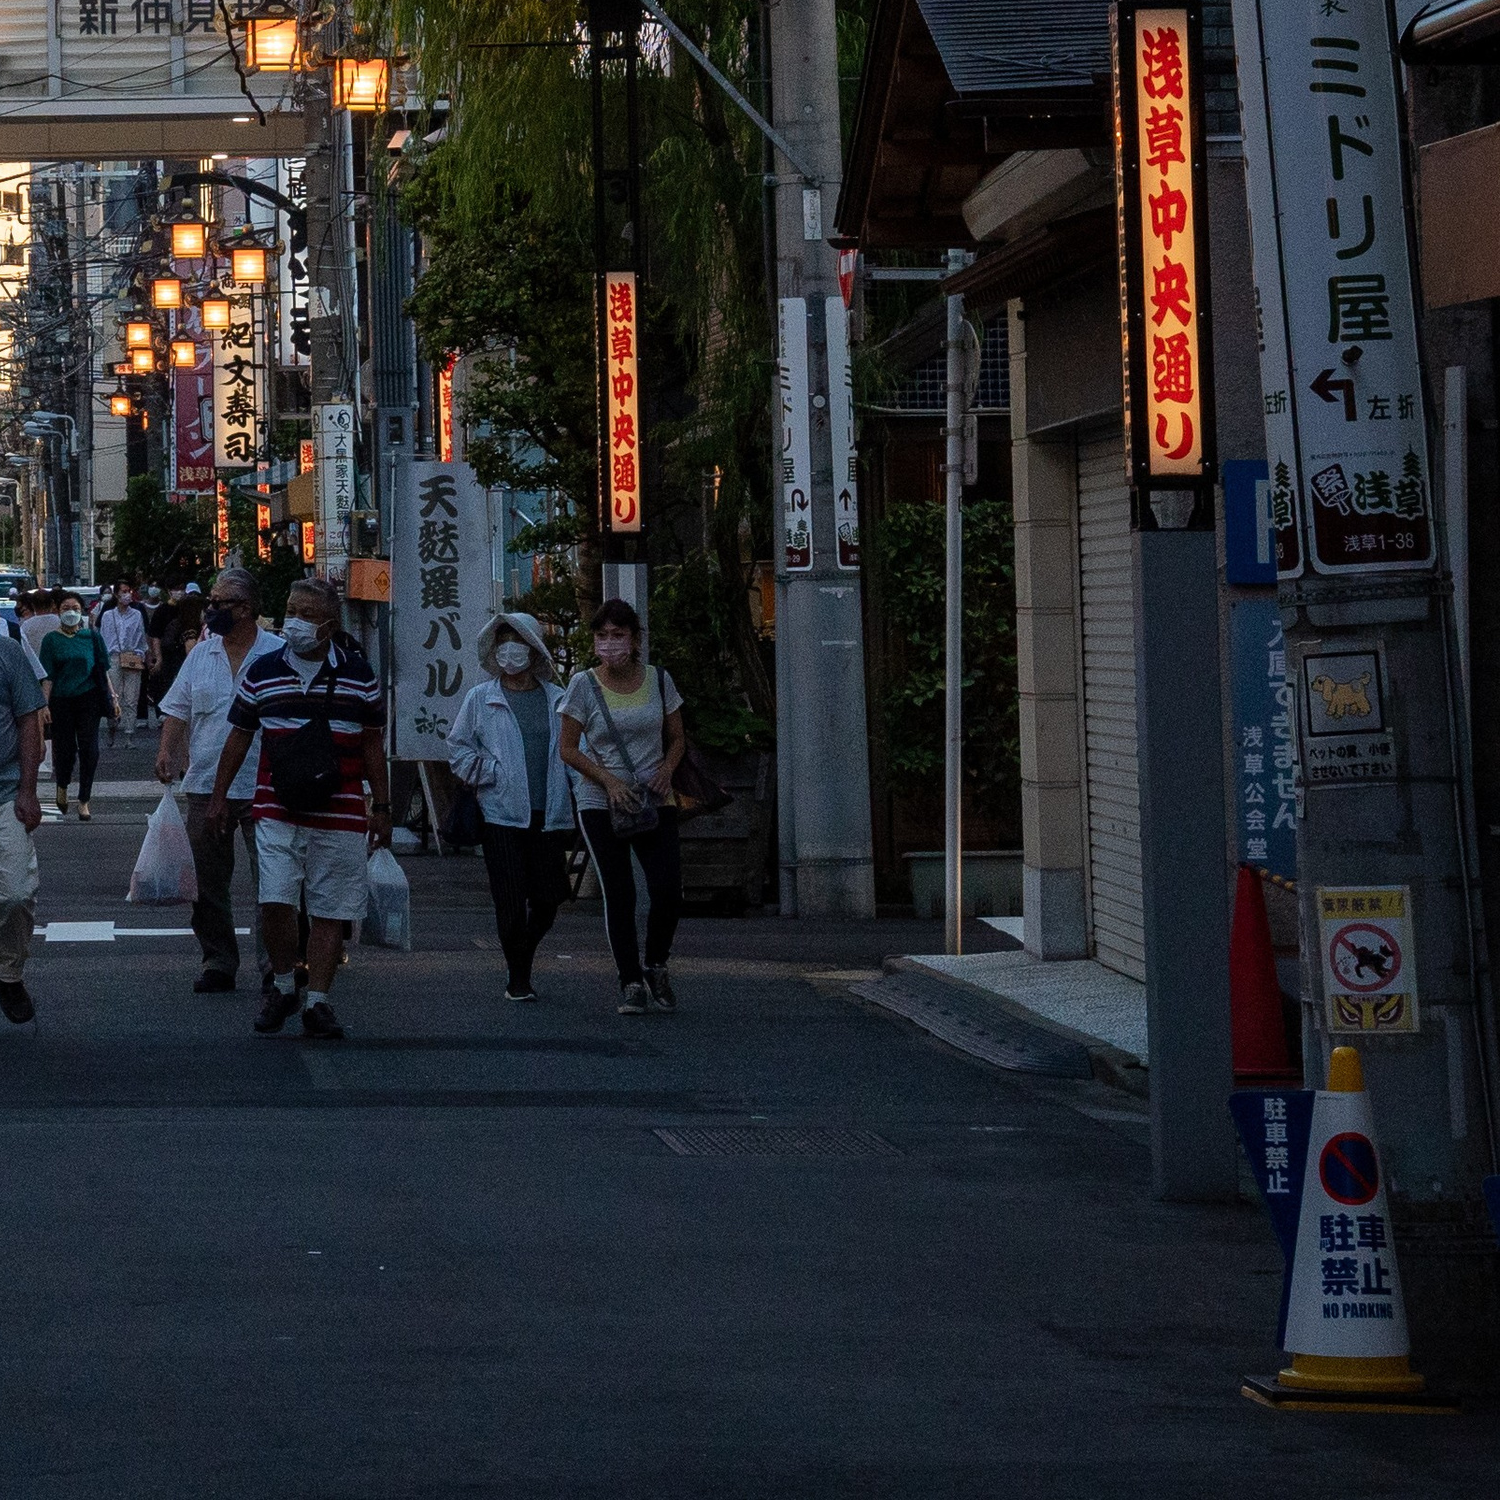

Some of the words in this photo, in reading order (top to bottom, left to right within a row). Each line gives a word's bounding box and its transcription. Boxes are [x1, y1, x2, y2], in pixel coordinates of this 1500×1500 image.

[1310, 37, 1393, 344] ミドリ屋
[1142, 26, 1194, 460] 浅草中央通り
[609, 283, 636, 524] 浅草中央通り
[1367, 394, 1414, 421] 左折
[179, 467, 215, 483] 浅草
[1354, 470, 1425, 519] 浅草
[1344, 533, 1415, 552] 浅草1-38
[1312, 762, 1392, 779] させないで下さい
[1242, 726, 1268, 860] 浅草公会堂
[1263, 1097, 1290, 1195] 駐車禁止
[1319, 1214, 1387, 1254] 駐車
[1322, 1257, 1392, 1296] 禁止
[1323, 1304, 1340, 1319] NO
[1342, 1303, 1394, 1319] PARKING
